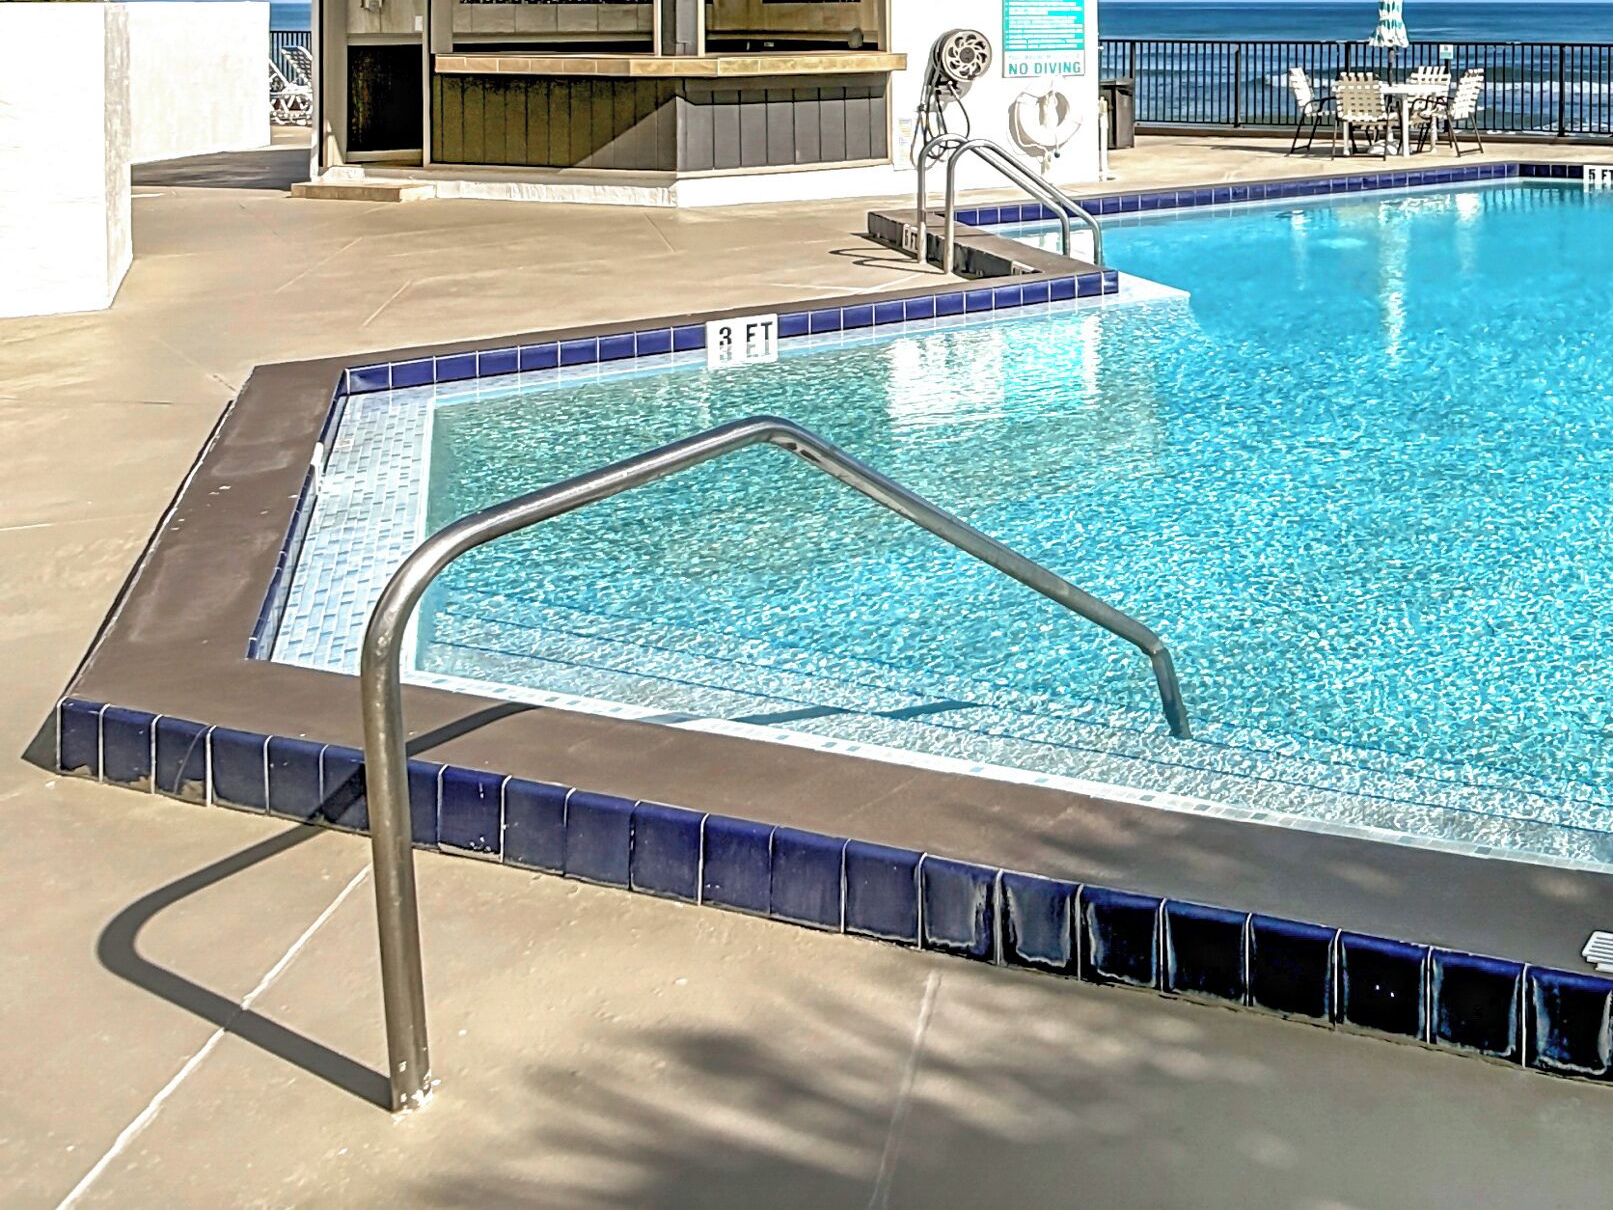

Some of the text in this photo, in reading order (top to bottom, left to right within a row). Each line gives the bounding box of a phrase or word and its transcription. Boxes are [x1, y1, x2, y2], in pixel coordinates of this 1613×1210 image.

[1008, 62, 1081, 75] NO DIVING
[1588, 168, 1596, 180] 5
[719, 321, 774, 346] 3 FT
